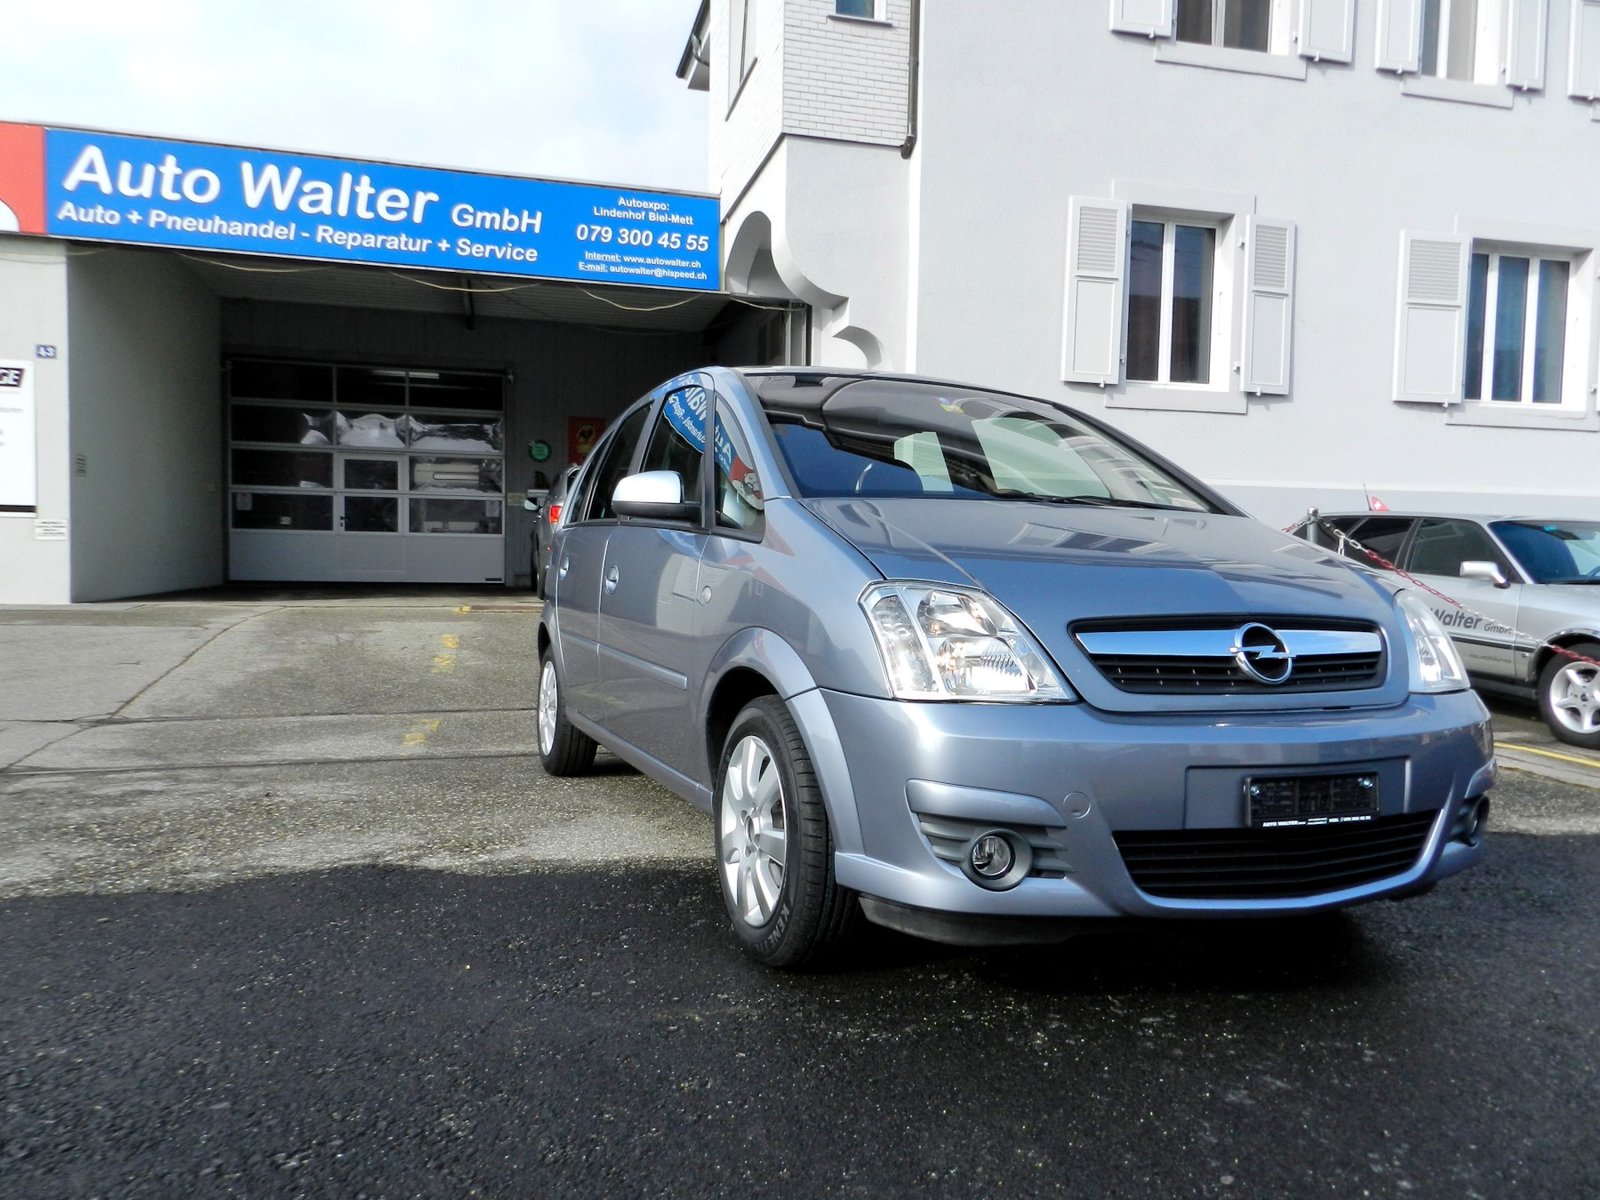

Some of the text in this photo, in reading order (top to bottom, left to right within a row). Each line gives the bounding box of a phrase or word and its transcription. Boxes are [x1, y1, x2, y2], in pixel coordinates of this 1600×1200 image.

[63, 144, 543, 234] Auto Walter GmbH
[618, 197, 670, 211] Autoexpo:
[593, 206, 694, 225] Lindenhof Biel-Mett
[58, 201, 121, 226] Auto
[127, 211, 144, 225] +
[150, 209, 296, 241] Pneuhandel
[316, 225, 432, 252] Reparatur
[437, 239, 451, 252] +
[456, 238, 539, 263] Service
[576, 224, 710, 252] 079 300 45 55
[585, 251, 702, 269] Internet: www.autowalter.ch
[579, 262, 708, 280] E-mail: autowalter@hispeed.ch
